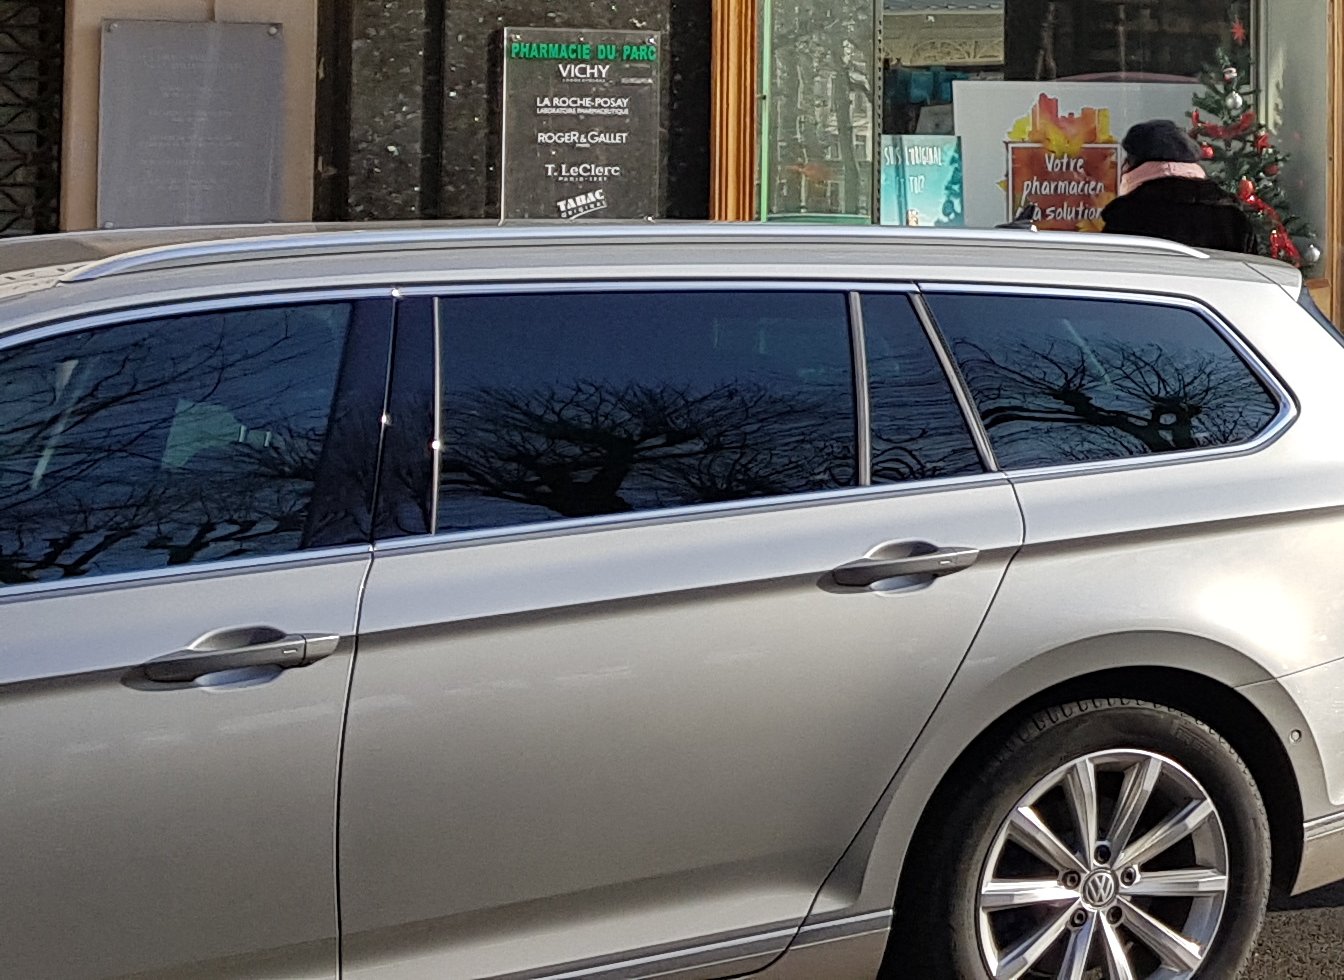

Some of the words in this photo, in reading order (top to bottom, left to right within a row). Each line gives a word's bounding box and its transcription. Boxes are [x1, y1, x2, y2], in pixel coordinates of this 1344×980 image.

[511, 42, 591, 59] PHARMACIE
[597, 44, 616, 59] DU
[623, 45, 657, 61] PARC
[558, 64, 610, 78] VICHY
[536, 97, 551, 107] LA
[552, 97, 630, 108] ROCHE-POSAY
[545, 164, 558, 176] T.
[561, 163, 621, 176] LeClerc
[1044, 152, 1084, 172] Votre
[556, 189, 605, 212] TABAC
[1023, 178, 1105, 206] pharmacien
